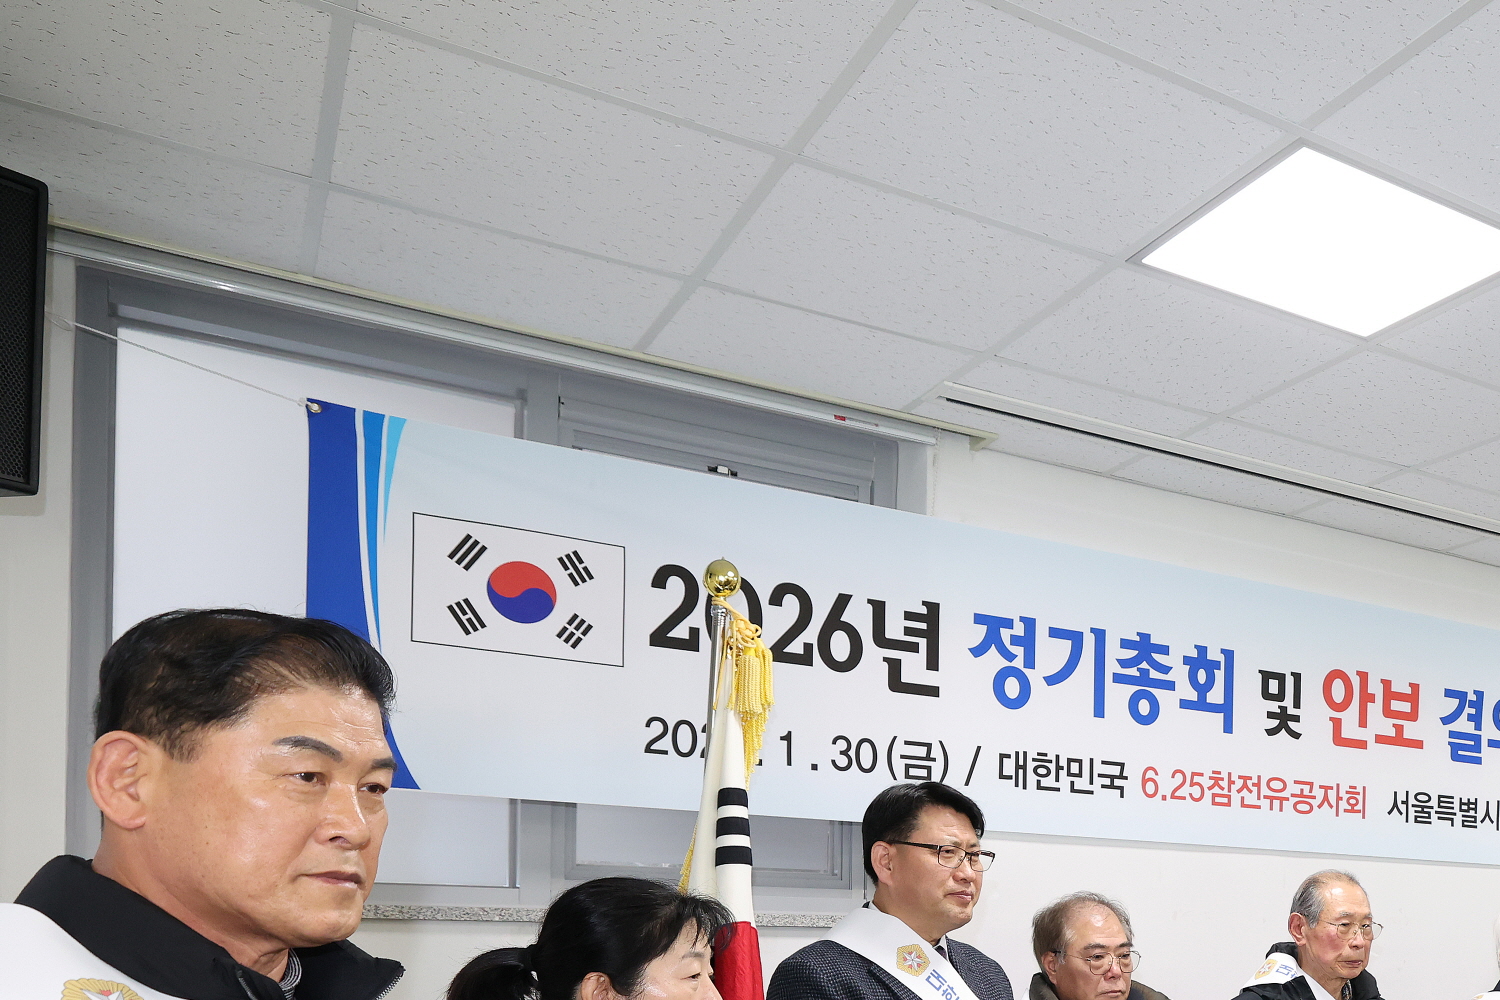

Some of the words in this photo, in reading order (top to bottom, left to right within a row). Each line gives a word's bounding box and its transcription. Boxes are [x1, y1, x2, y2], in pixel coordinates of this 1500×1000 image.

[968, 611, 1236, 734] 정기총회
[1258, 669, 1304, 741] 및
[1321, 667, 1424, 751] 안보
[998, 749, 1129, 799] 대한민국
[1140, 767, 1368, 820] 6.25참전유공자회
